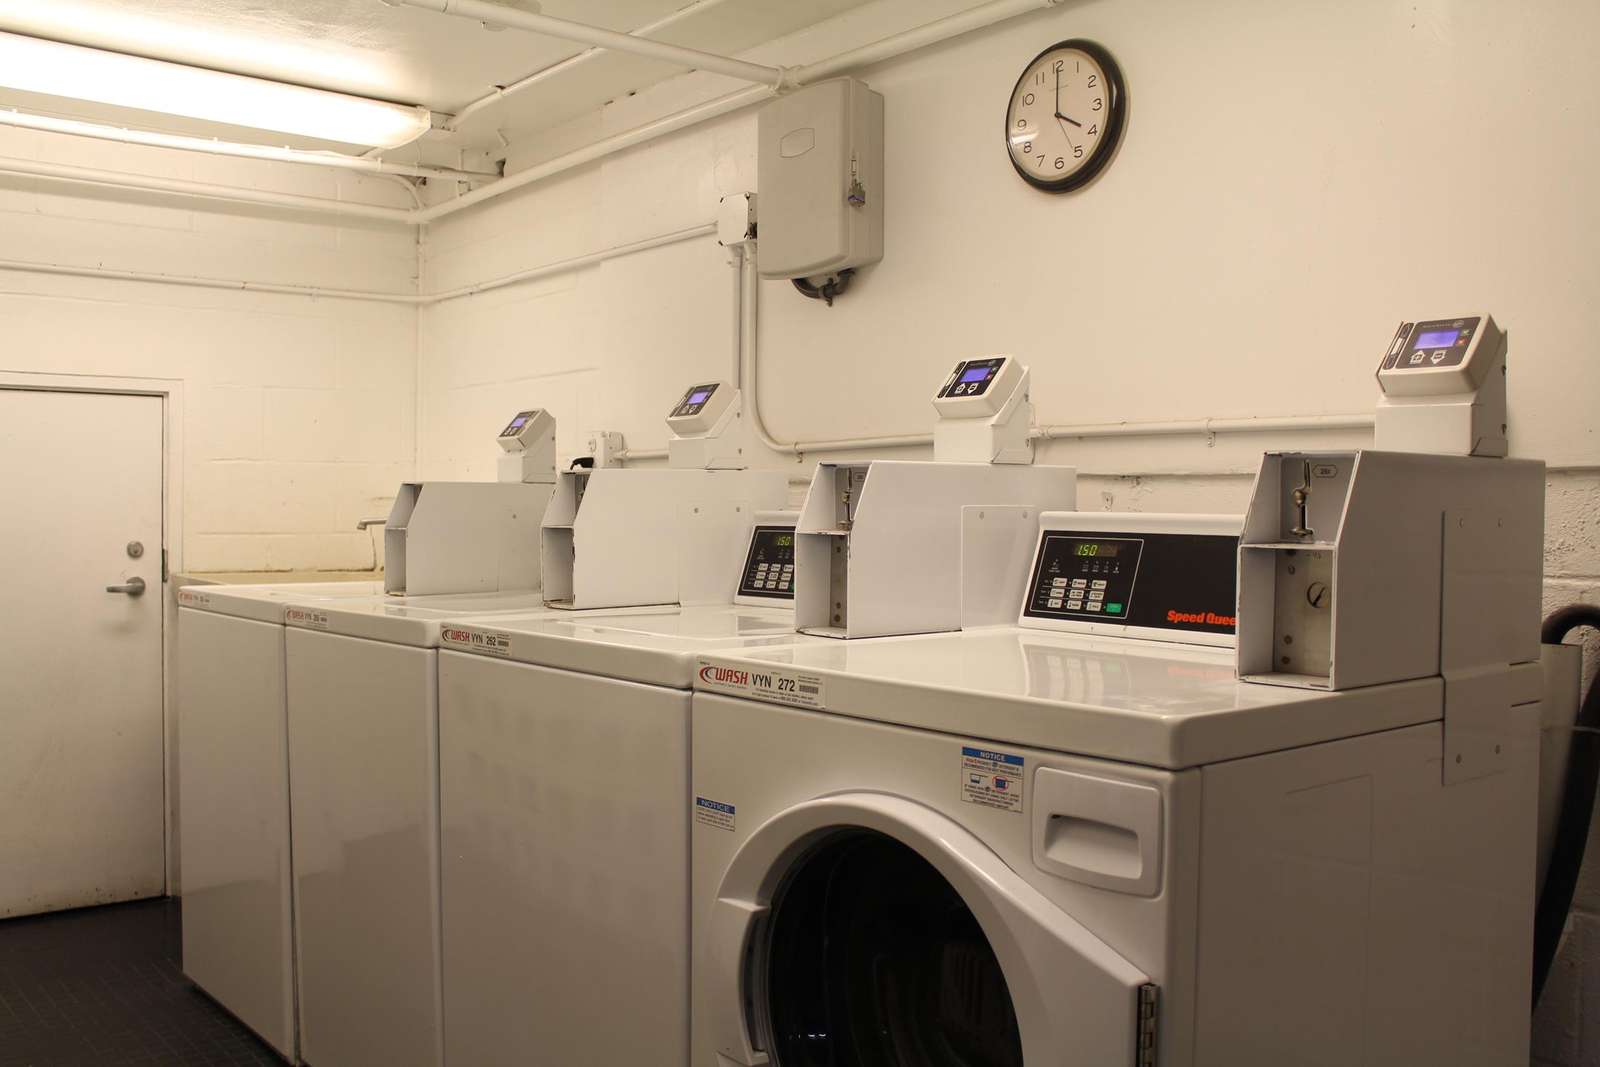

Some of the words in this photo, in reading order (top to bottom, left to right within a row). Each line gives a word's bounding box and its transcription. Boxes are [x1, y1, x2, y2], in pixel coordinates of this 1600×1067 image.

[1052, 60, 1065, 74] 12
[1035, 72, 1045, 86] 11
[1087, 75, 1097, 88] 2
[1022, 93, 1035, 107] 10
[1092, 98, 1103, 111] 3
[1017, 119, 1027, 131] 9
[1087, 124, 1098, 136] 4
[1023, 142, 1032, 153] 8
[1073, 145, 1084, 158] 5
[1036, 154, 1046, 167] 7
[1054, 157, 1065, 169] 6
[1167, 610, 1206, 624] Speed
[1206, 612, 1239, 625] Quee
[451, 630, 470, 642] WASH
[471, 633, 483, 644] VYN
[715, 667, 748, 685] WASH
[752, 673, 771, 688] VYN
[778, 678, 795, 692] 272
[980, 751, 1006, 761] NOTICE
